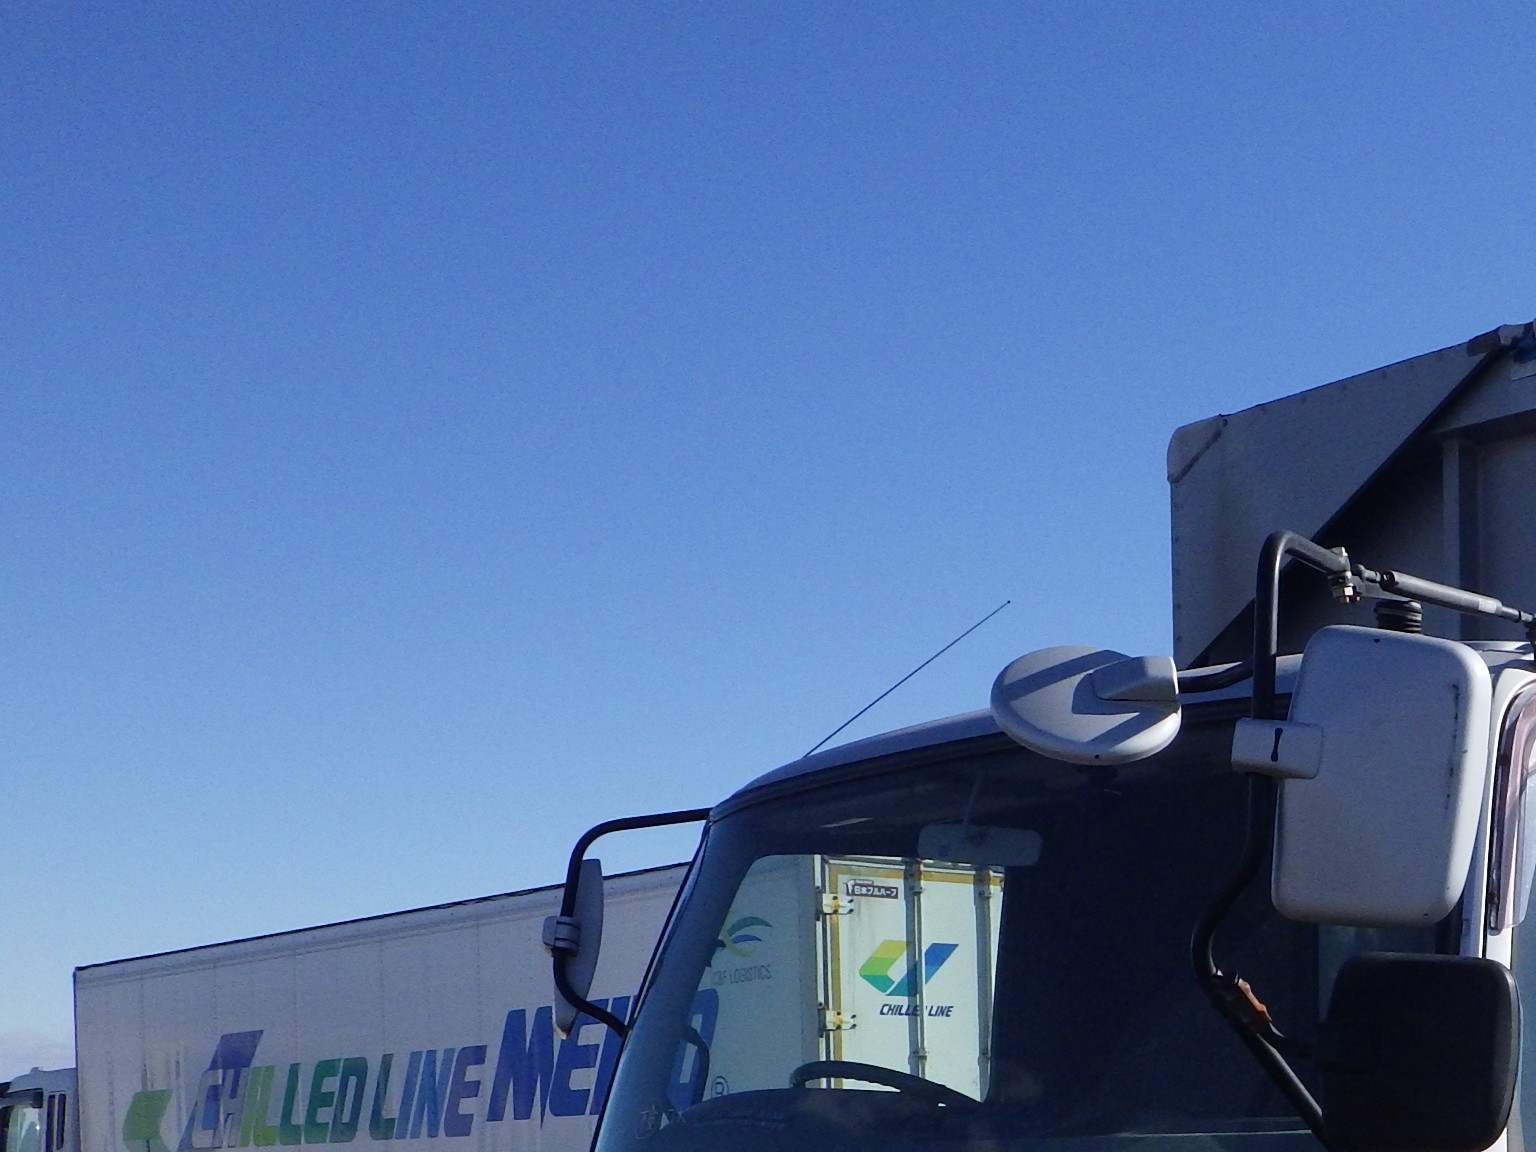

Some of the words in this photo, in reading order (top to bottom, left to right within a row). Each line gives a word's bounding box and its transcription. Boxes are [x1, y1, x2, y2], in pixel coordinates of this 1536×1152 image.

[854, 885, 897, 897] 日本フルハーフ
[729, 963, 772, 985] LOGISTICS
[879, 1003, 927, 1017] CHILLE
[927, 1005, 954, 1018] LINE
[191, 1056, 368, 1149] CHILLED
[369, 1043, 487, 1142] LINE
